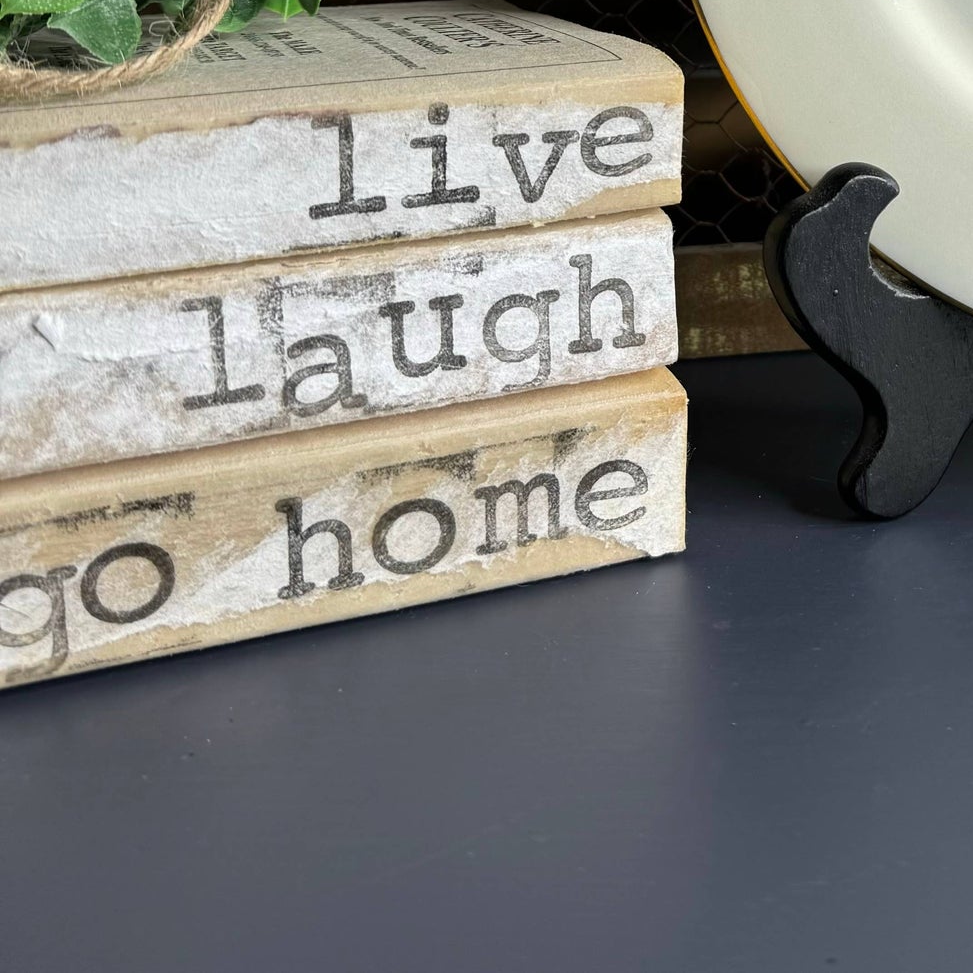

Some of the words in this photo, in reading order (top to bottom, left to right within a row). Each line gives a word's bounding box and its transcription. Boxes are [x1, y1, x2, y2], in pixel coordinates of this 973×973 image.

[308, 103, 654, 218] live
[180, 253, 645, 418] laugh
[0, 541, 176, 682] go
[275, 459, 649, 599] home
